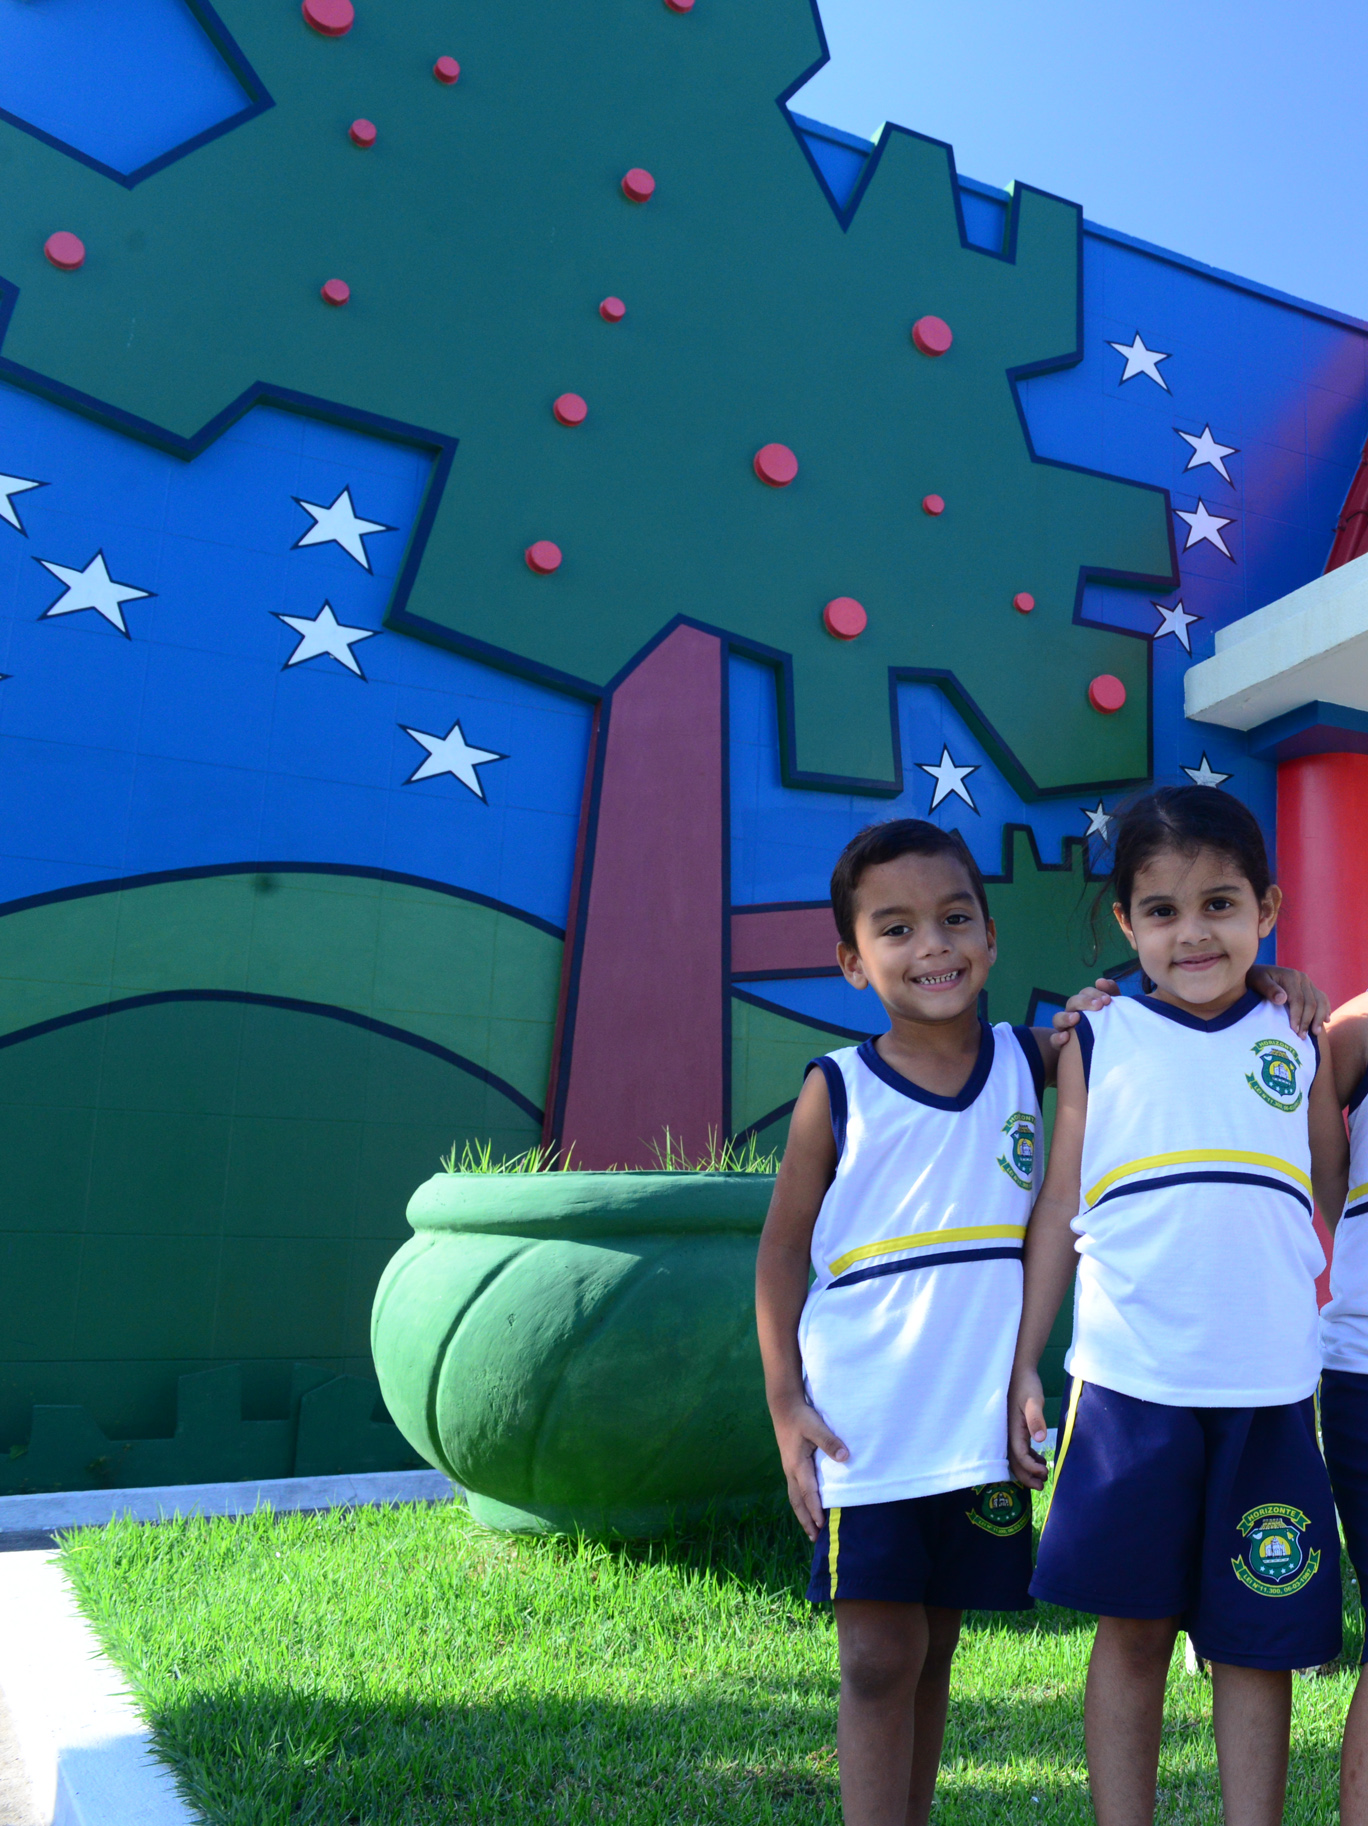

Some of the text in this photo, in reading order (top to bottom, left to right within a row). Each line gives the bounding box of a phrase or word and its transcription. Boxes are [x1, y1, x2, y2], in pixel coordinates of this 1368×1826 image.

[1259, 1040, 1296, 1055] HORIZONTE
[1247, 1506, 1297, 1521] HORIZONTE
[1243, 1574, 1252, 1584] LEI
